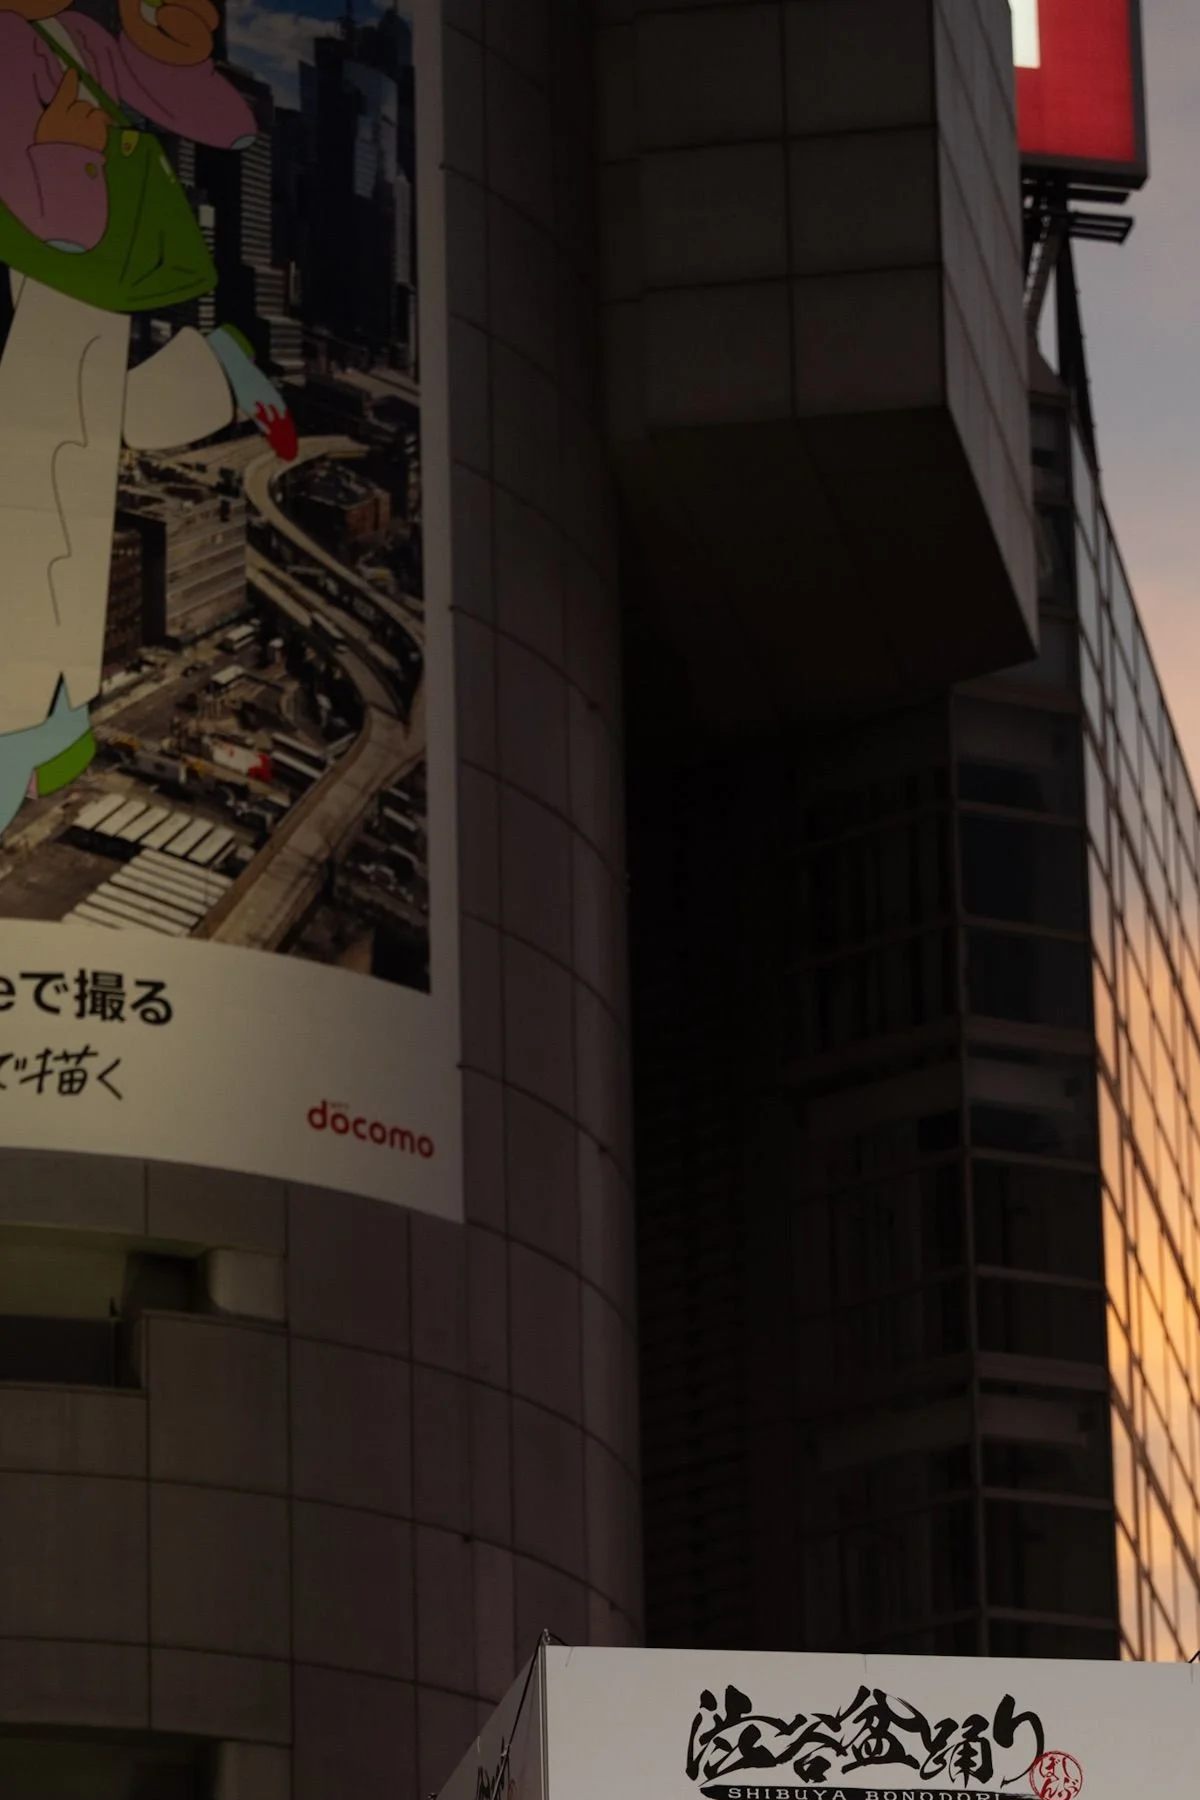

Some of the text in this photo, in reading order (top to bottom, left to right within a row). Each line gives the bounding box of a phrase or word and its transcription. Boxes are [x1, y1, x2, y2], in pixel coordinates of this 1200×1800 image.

[306, 1099, 435, 1159] docomo
[686, 1684, 1045, 1787] 渋谷盆踊り
[727, 1787, 848, 1800] SHIBUYA
